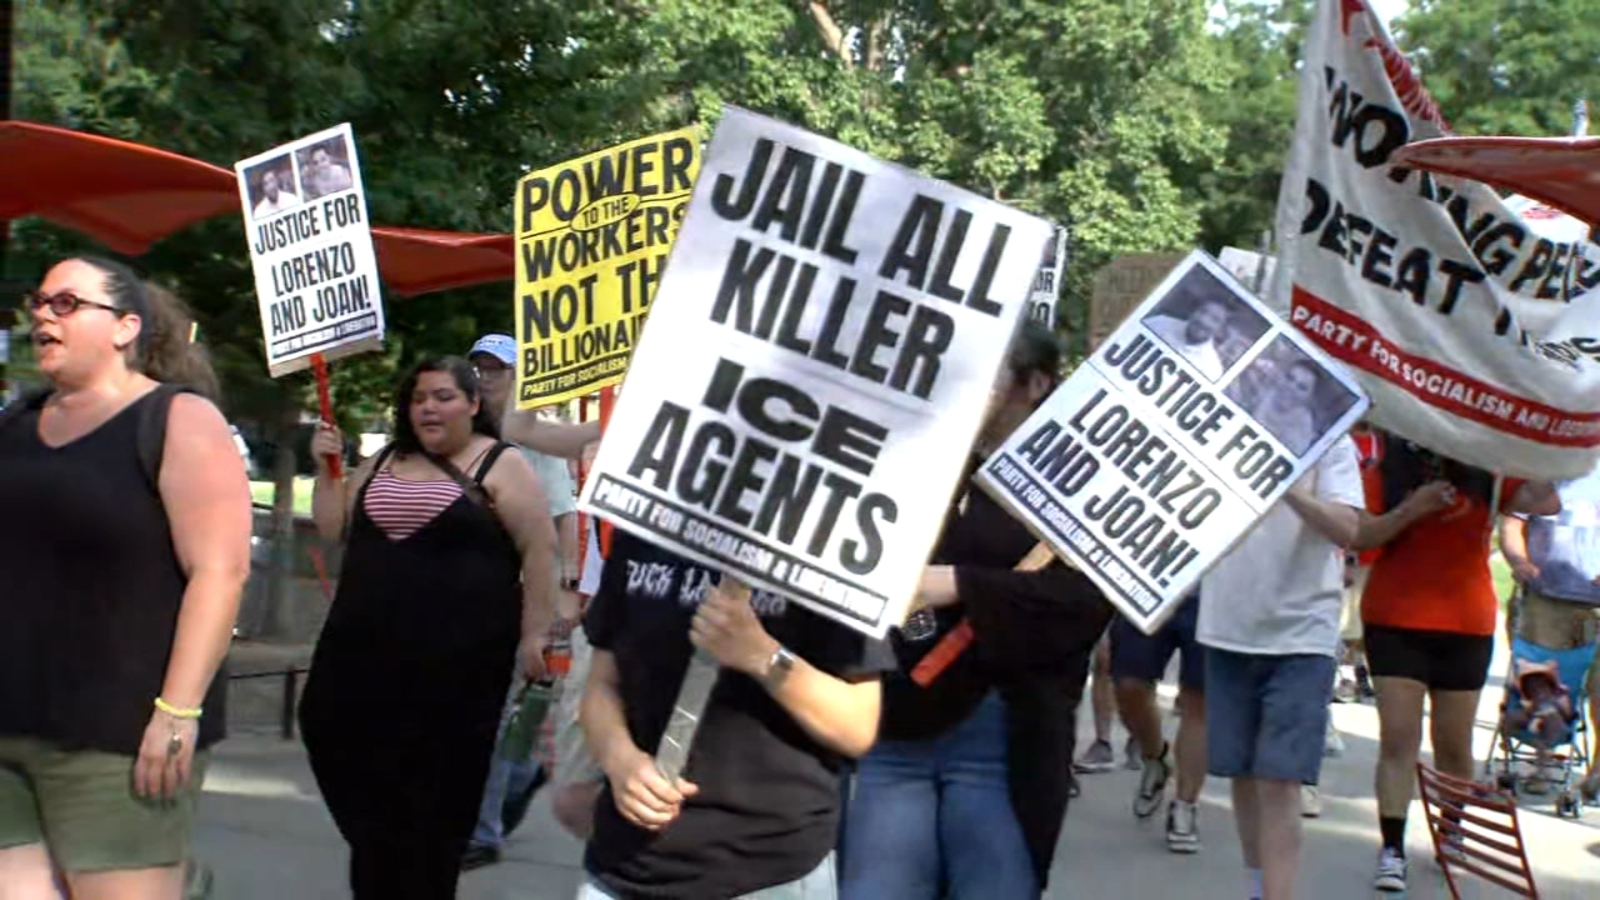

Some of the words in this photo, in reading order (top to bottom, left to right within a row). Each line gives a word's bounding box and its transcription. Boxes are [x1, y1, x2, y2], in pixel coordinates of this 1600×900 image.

[254, 206, 320, 255] JUSTICE
[323, 193, 361, 231] FOR
[522, 137, 693, 233] POWER
[583, 207, 599, 228] TO
[602, 197, 629, 220] THE
[711, 137, 866, 266] JAIL
[878, 193, 1012, 318] ALL
[270, 295, 307, 336] AND
[312, 274, 372, 323] JOAN!
[271, 242, 356, 297] LORENZO
[522, 274, 598, 344] NOT
[709, 238, 955, 401] KILLER
[524, 377, 556, 396] PARTY
[558, 373, 576, 388] FOR
[1292, 304, 1367, 350] PARTY
[1370, 340, 1400, 373] FOR
[1400, 363, 1513, 420] SOCIALISM
[700, 356, 891, 478] ICE
[1068, 387, 1222, 531] LORENZO
[1104, 332, 1235, 446] JUSTICE
[1215, 424, 1295, 500] FOR
[598, 478, 649, 518] PARTY
[649, 501, 684, 533] FOR
[683, 519, 773, 574] SOCIALISM
[770, 559, 788, 582] &
[626, 400, 899, 576] AGENTS
[992, 457, 1027, 494] PARTY
[1021, 483, 1048, 511] FOR
[1039, 501, 1097, 556] SOCIALISM
[1014, 419, 1100, 497] AND
[1083, 484, 1200, 589] JOAN!
